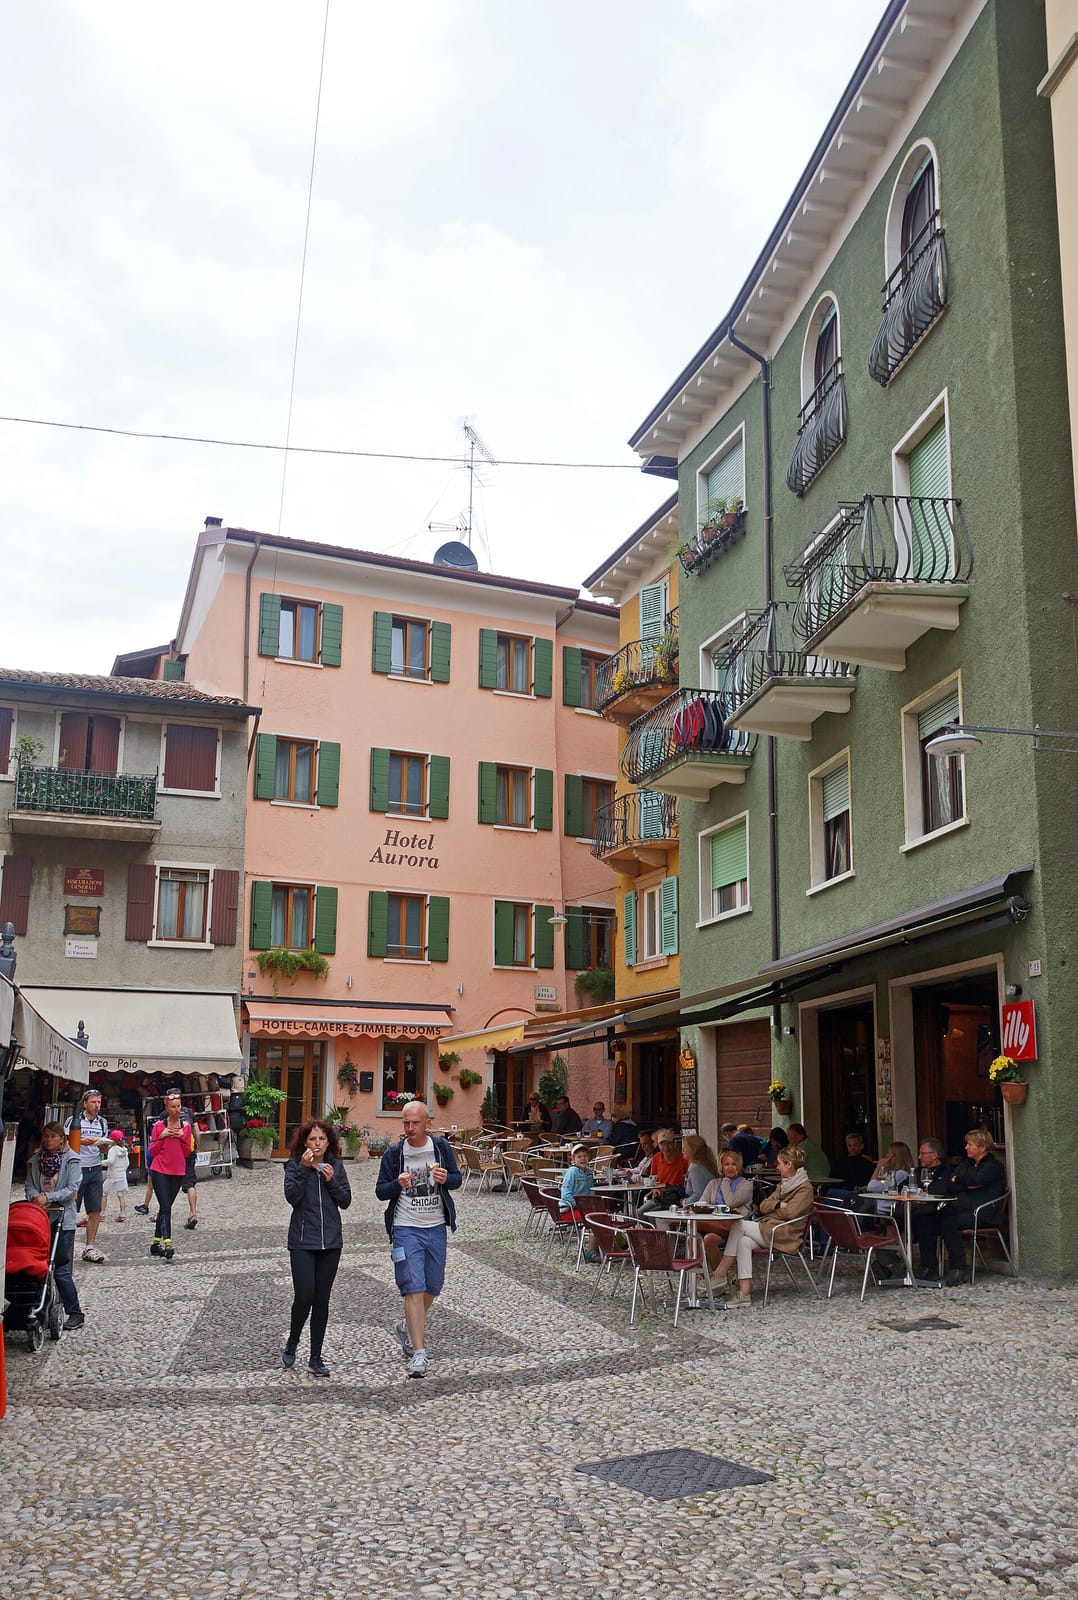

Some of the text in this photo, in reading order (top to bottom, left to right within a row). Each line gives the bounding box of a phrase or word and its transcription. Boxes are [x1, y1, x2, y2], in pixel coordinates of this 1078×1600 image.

[383, 829, 435, 850] Hotel
[369, 846, 440, 869] Aurora
[1003, 1010, 1030, 1056] illy
[117, 1058, 138, 1069] Polo
